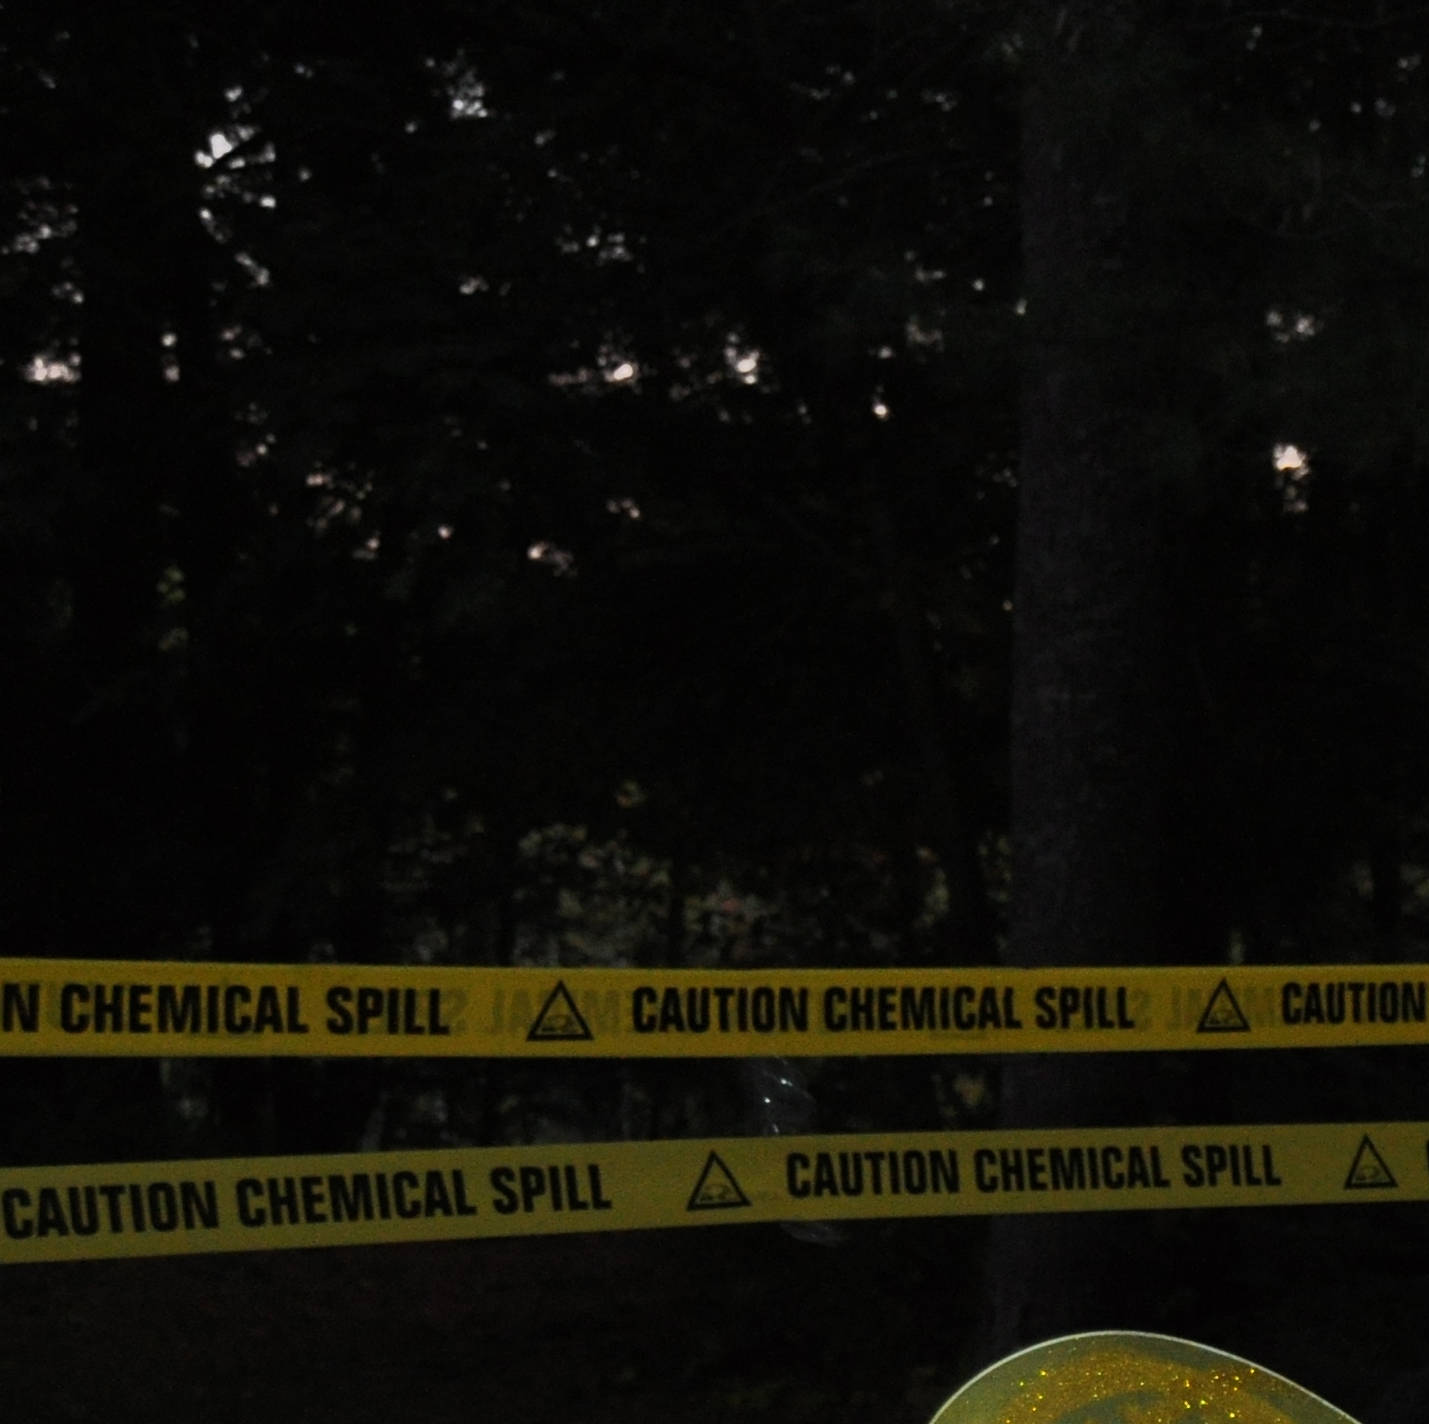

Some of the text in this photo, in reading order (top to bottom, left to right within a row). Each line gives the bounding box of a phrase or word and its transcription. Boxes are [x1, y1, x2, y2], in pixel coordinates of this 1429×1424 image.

[60, 983, 309, 1034] CHEMICAL
[326, 986, 450, 1035] SPILL
[632, 986, 809, 1033] CAUTION
[823, 986, 1021, 1032] CHEMICAL
[1034, 985, 1135, 1030] SPILL
[1282, 981, 1427, 1024] CAUTION
[786, 1144, 1283, 1197] CAUTION CHEMICAL SPILL
[2, 1161, 613, 1240] CAUTION CHEMICAL SPILL
